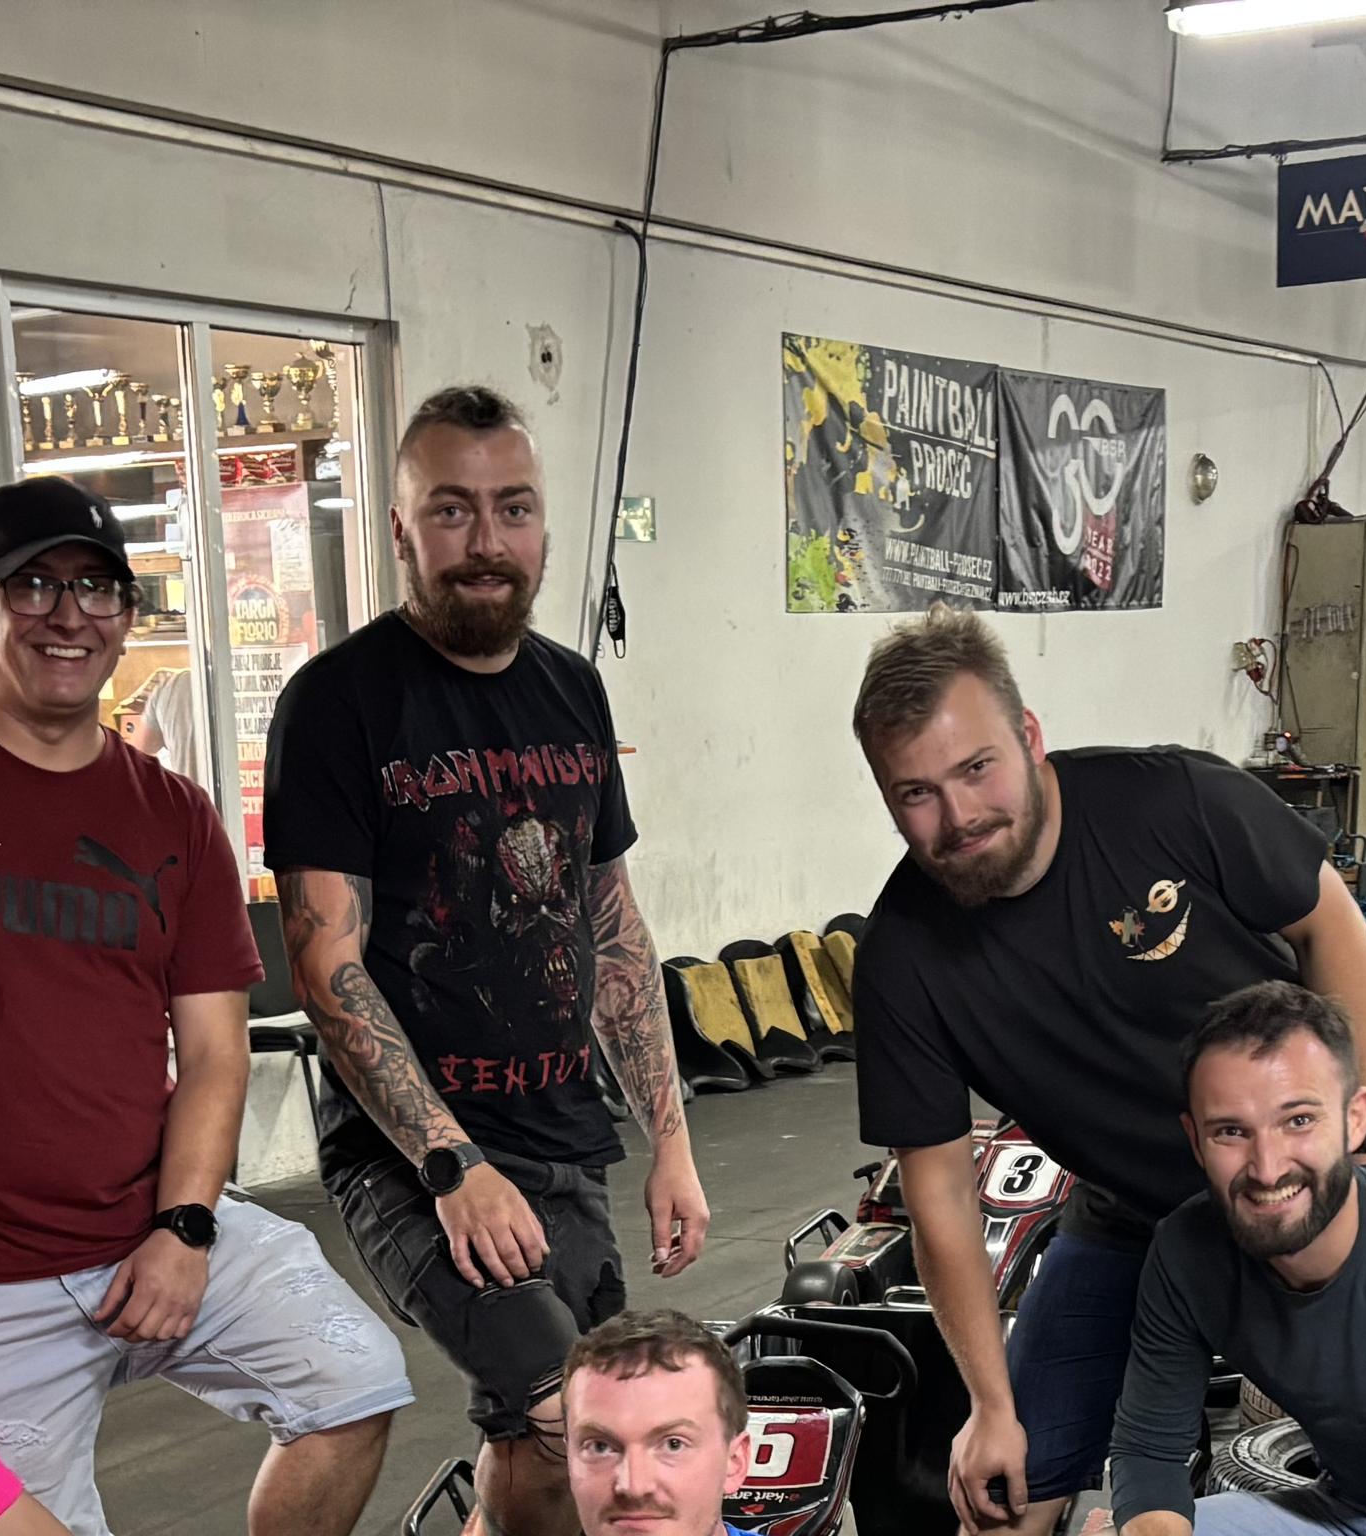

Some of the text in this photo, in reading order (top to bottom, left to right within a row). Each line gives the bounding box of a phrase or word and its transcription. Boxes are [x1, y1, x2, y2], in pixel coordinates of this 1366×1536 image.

[882, 359, 996, 450] PAINTBALL
[910, 440, 972, 499] PROSEC
[234, 598, 276, 620] TARGA
[236, 620, 278, 642] FLORIO
[381, 743, 609, 812] IRON MAIDEN
[999, 1153, 1045, 1196] 3
